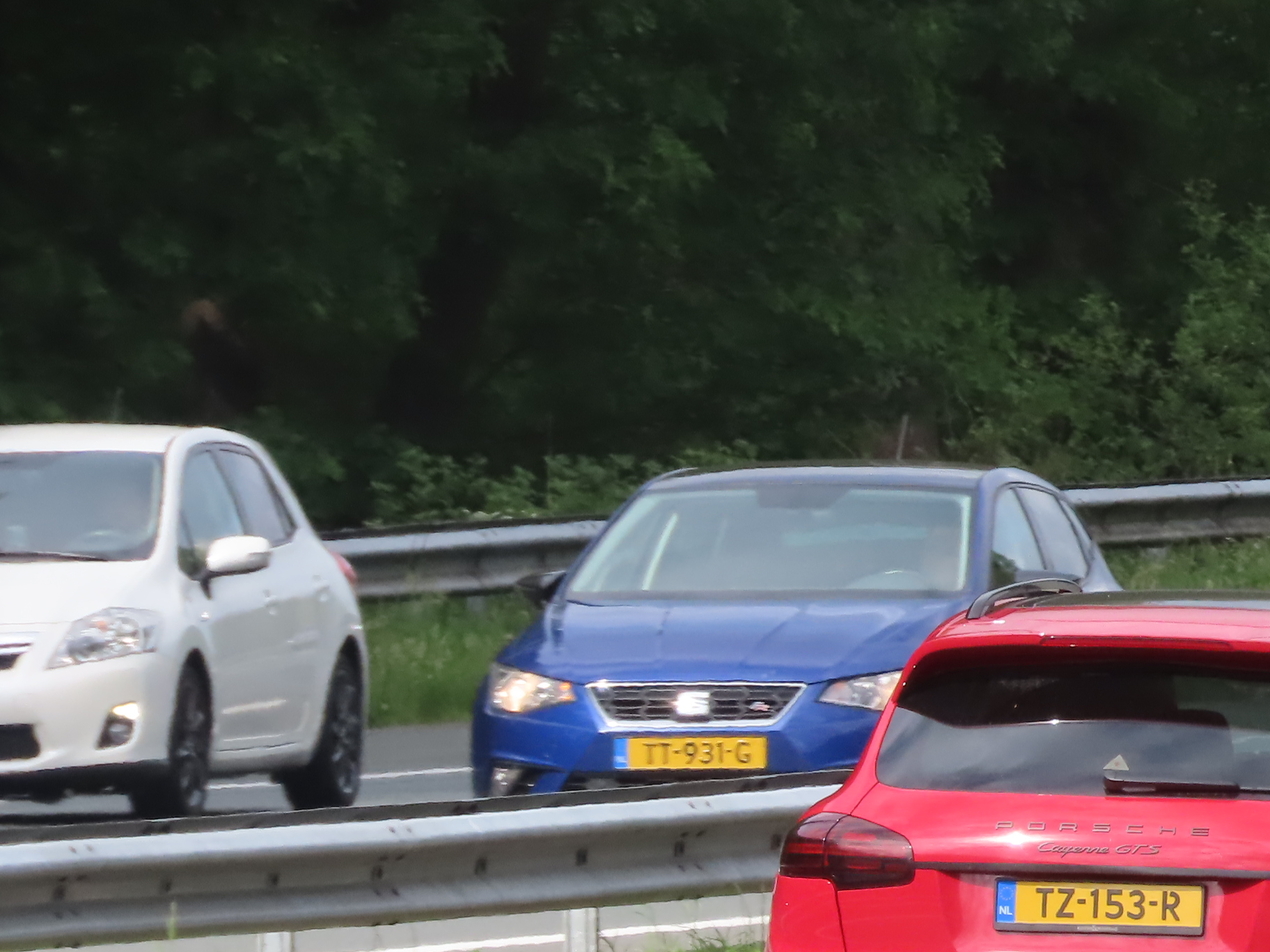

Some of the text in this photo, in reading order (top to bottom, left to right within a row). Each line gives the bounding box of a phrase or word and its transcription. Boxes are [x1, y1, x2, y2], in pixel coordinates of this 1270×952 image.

[642, 741, 752, 765] TT-931-G
[995, 821, 1210, 836] PORSCHE
[1037, 842, 1162, 857] Cayenne GTS
[999, 905, 1013, 915] NL
[1036, 887, 1181, 921] TZ-153-R
